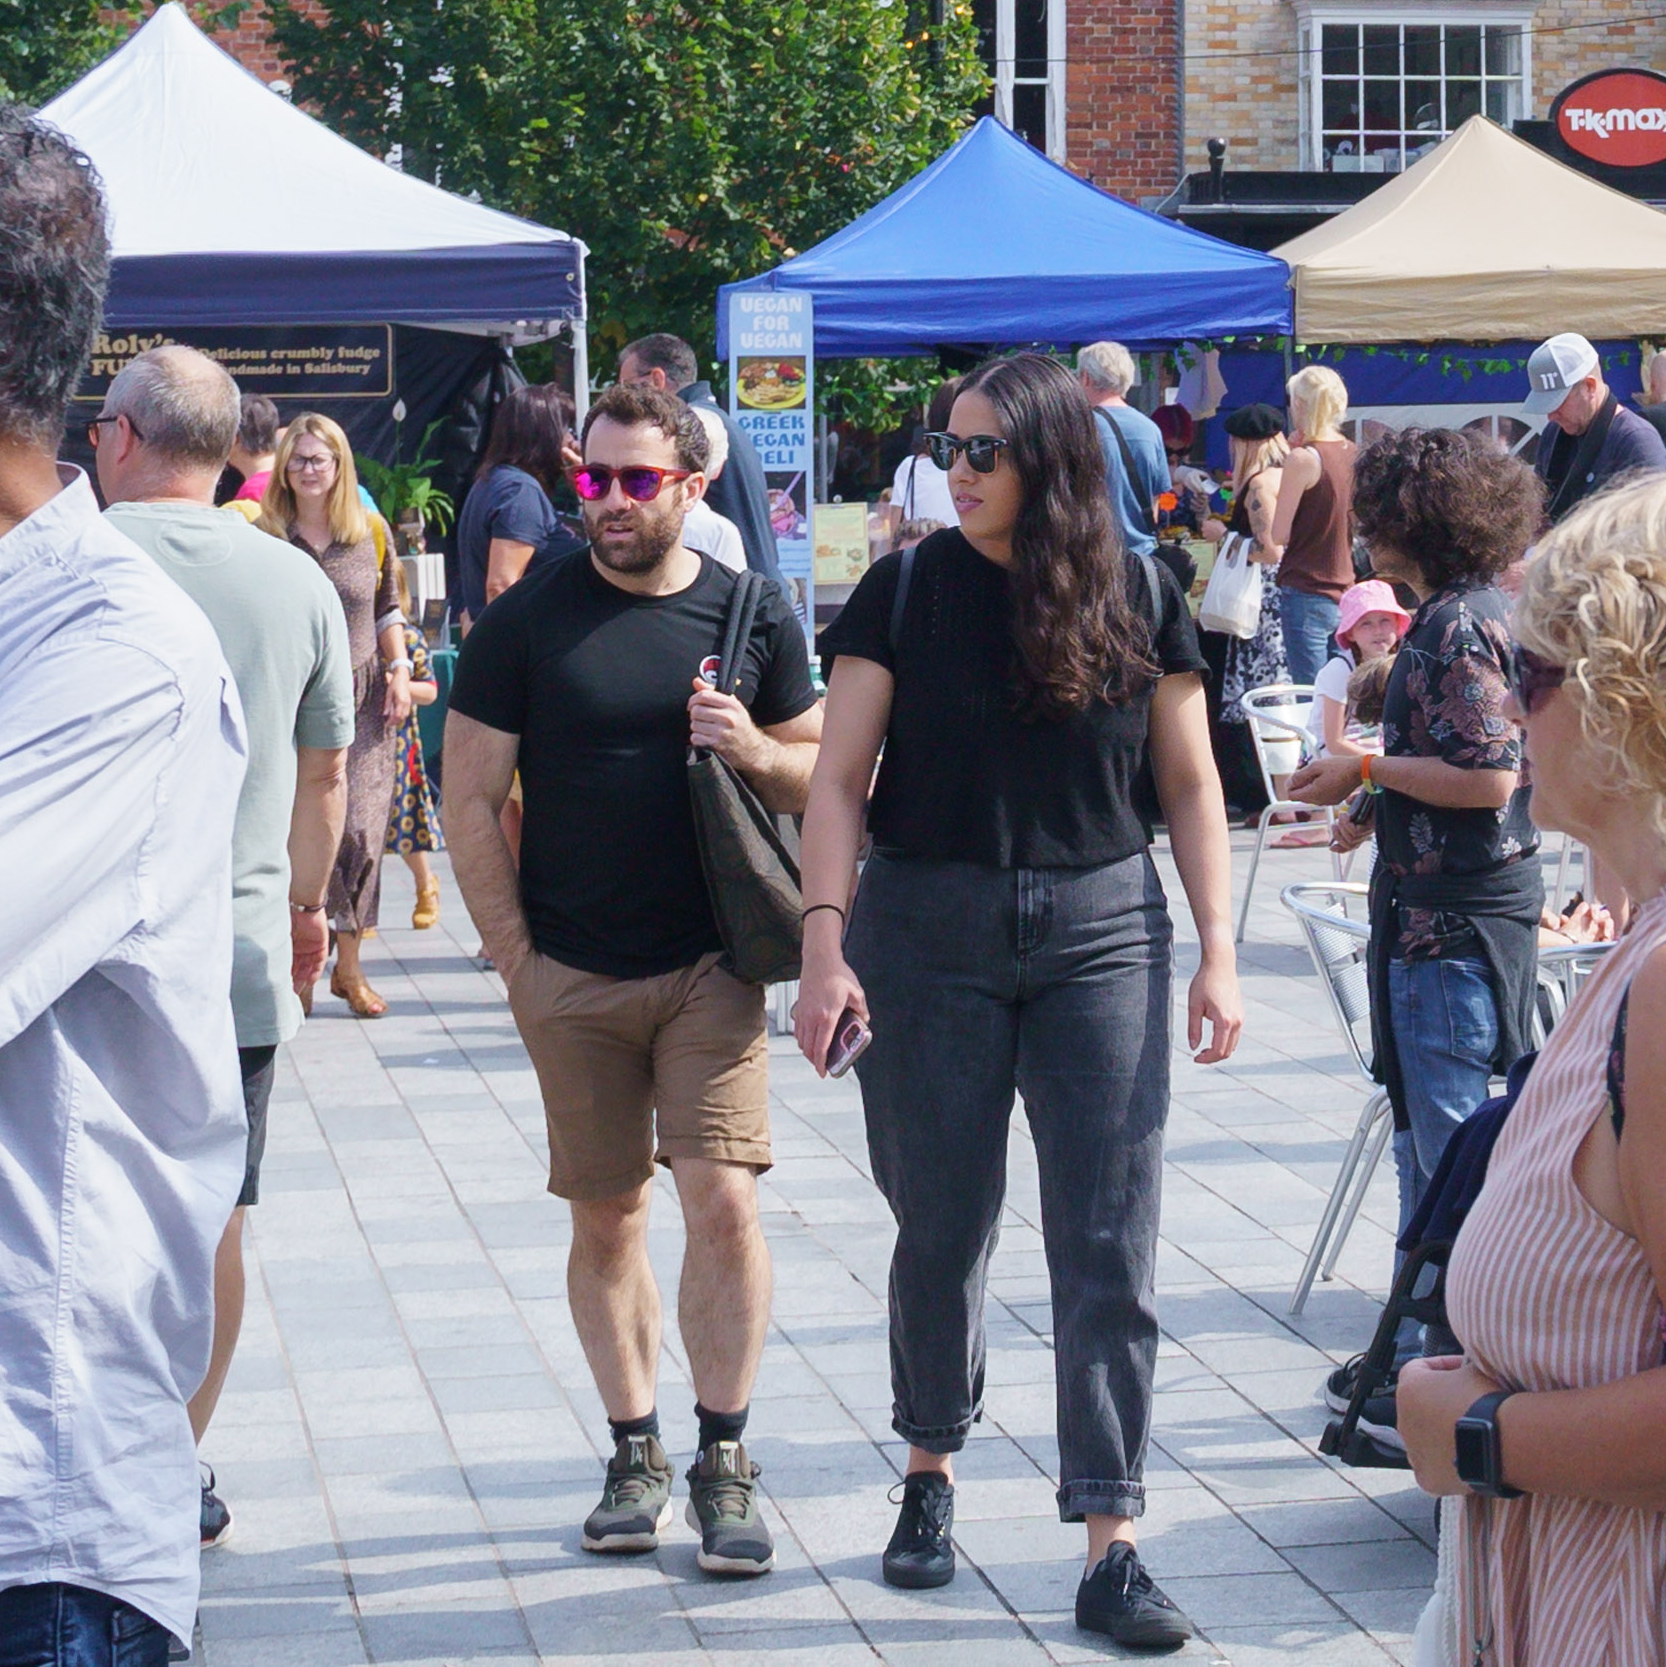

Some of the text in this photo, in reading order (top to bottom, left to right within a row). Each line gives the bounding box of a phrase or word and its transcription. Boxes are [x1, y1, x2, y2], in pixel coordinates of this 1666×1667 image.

[740, 297, 803, 313] VEGAN
[753, 315, 790, 331] FOR
[740, 332, 803, 349] VEGAN
[270, 347, 334, 361] crumbly
[338, 346, 381, 361] fudge
[286, 363, 301, 375] in
[304, 362, 372, 377] Salisbury
[738, 415, 805, 430] GREEK
[750, 433, 805, 447] EGAN
